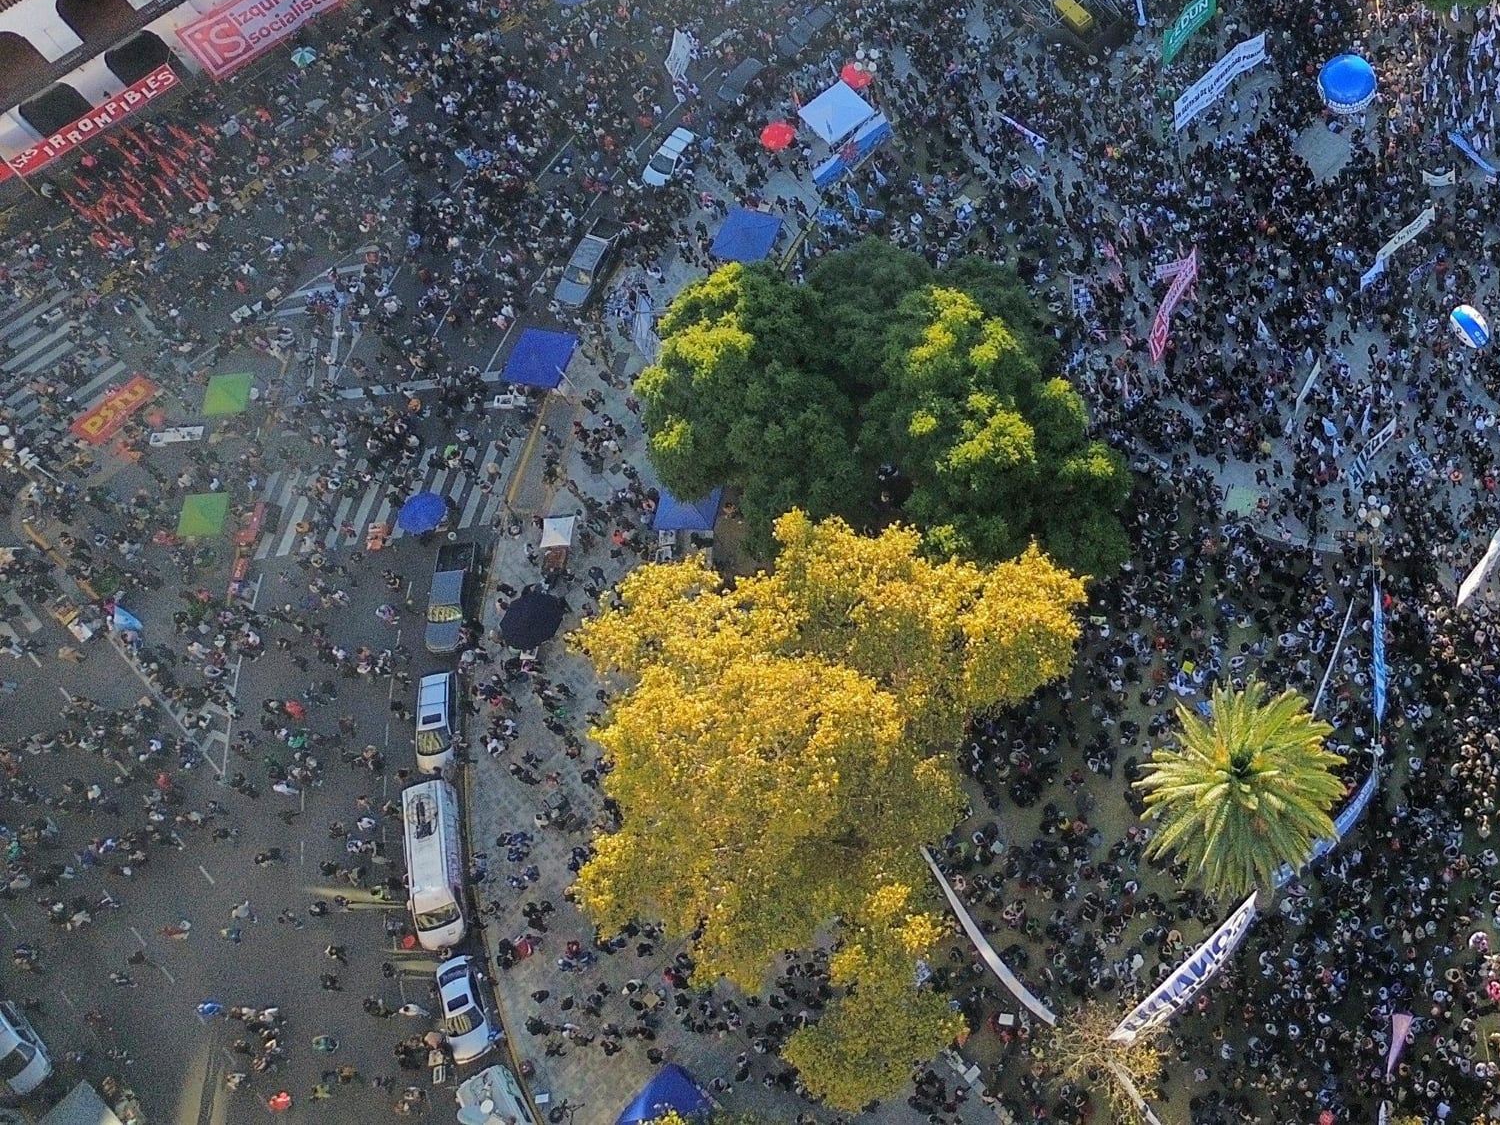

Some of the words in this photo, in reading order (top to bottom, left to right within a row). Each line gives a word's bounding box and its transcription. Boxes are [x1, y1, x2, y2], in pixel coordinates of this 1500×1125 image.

[196, 11, 248, 63] iS
[43, 69, 175, 157] IRROMPIBLES
[82, 385, 146, 434] PSTU
